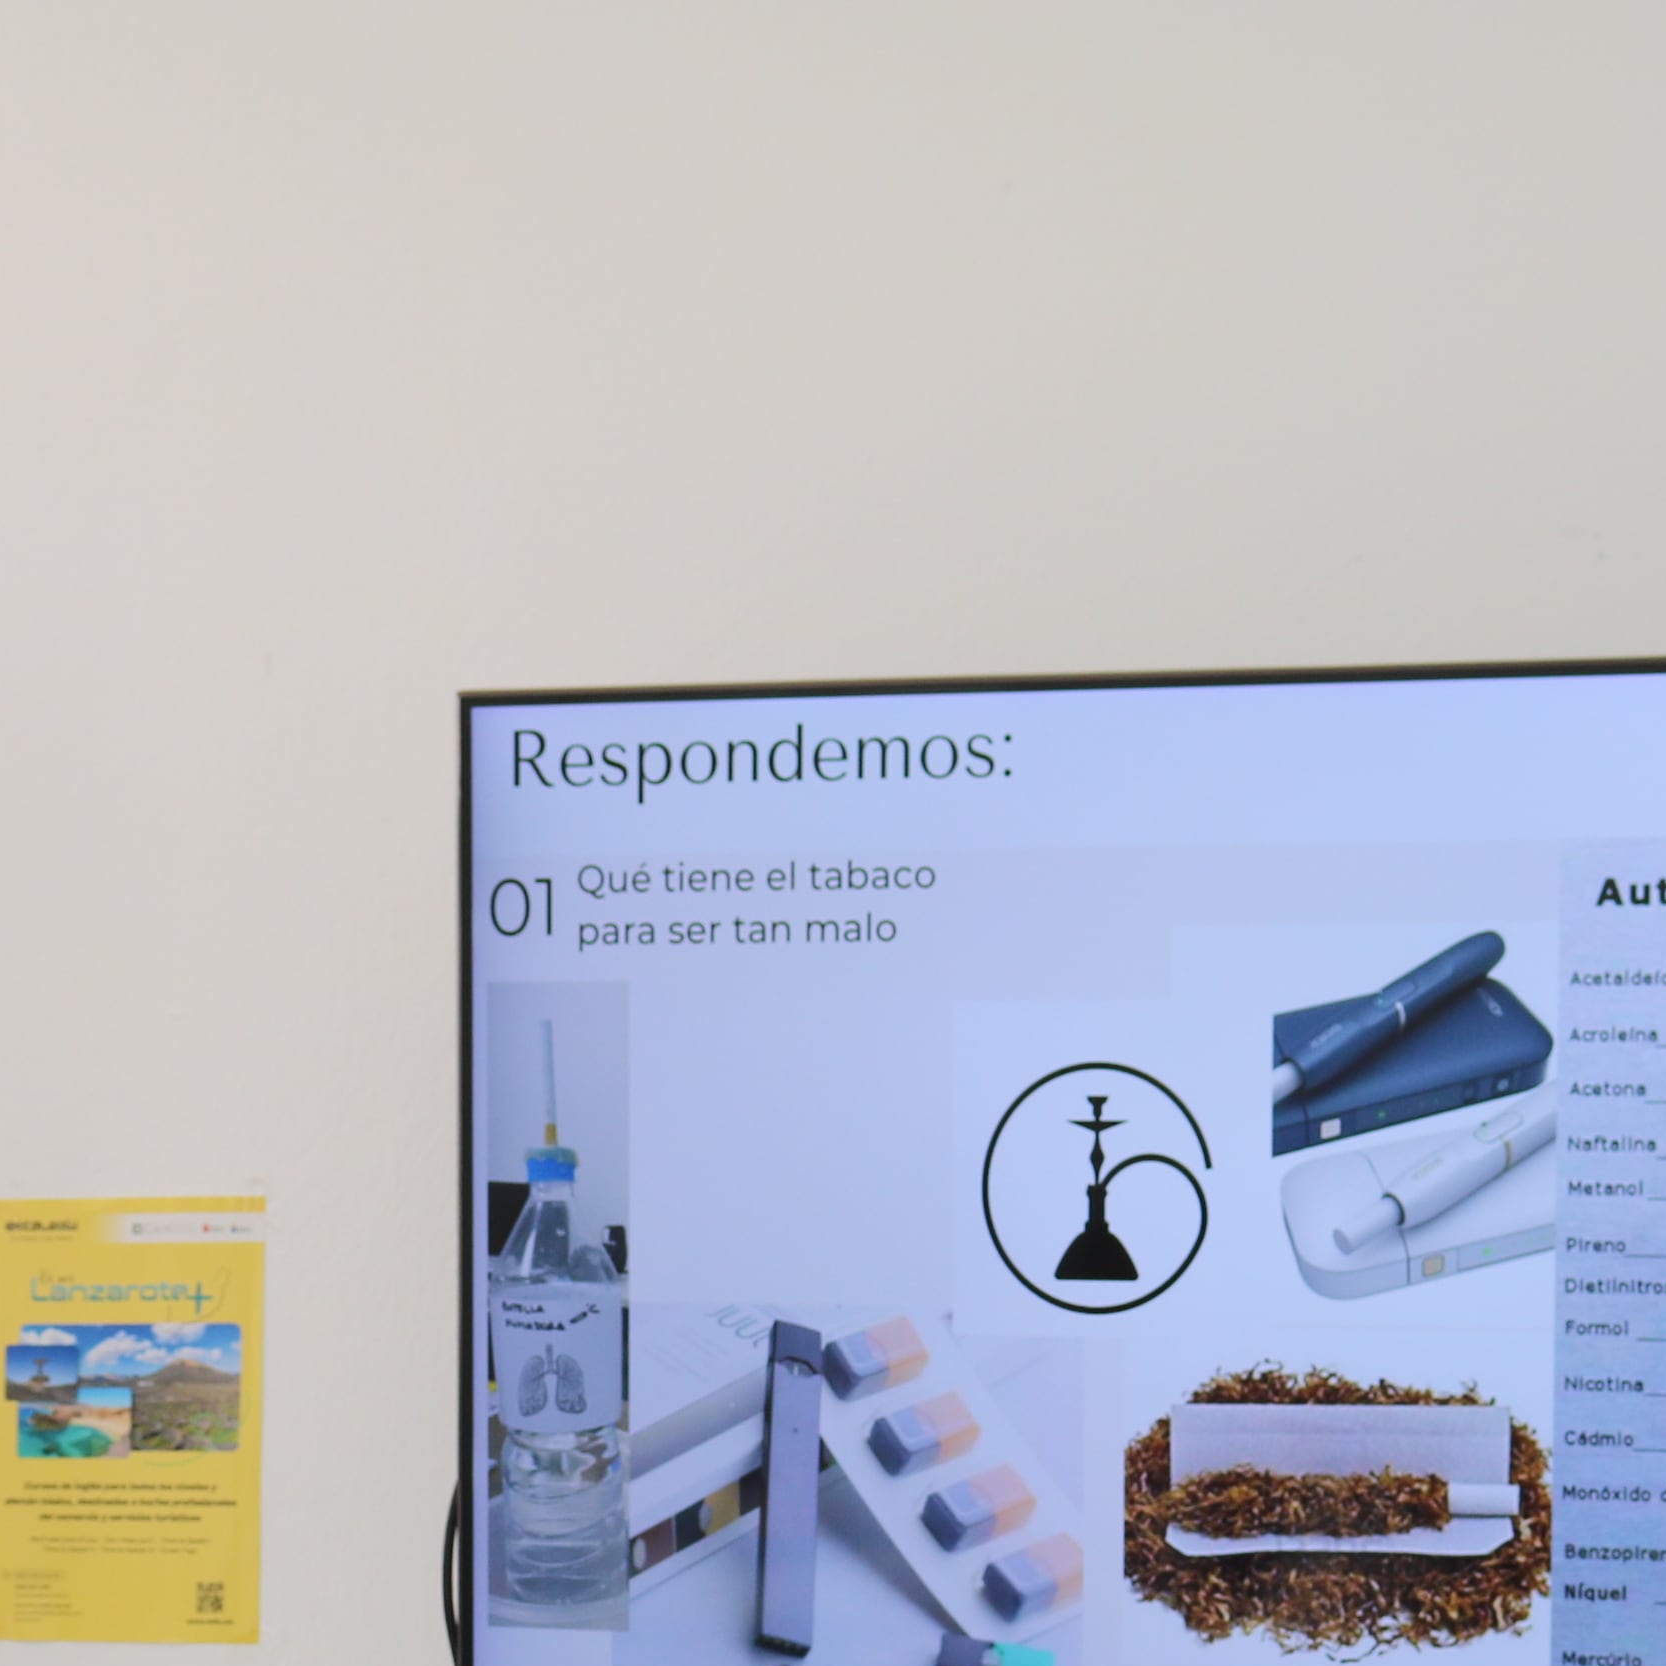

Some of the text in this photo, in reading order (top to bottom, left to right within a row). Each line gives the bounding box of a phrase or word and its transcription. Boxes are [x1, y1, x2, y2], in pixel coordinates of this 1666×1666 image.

[512, 723, 1013, 804] Respondemos:
[578, 860, 936, 898] Qué tiene el tabaco
[490, 878, 552, 936] 01
[578, 912, 897, 952] para ser tan malo
[1569, 1026, 1658, 1043] Acroleína
[1569, 1081, 1647, 1097] Acetona
[1567, 1135, 1657, 1152] Naftalina
[1567, 1180, 1644, 1197] Metanol
[1565, 1236, 1627, 1253] Pireno
[1564, 1319, 1630, 1336] Formol
[1564, 1375, 1645, 1393] Nicotina
[1564, 1429, 1635, 1447] Cádmio
[1562, 1484, 1652, 1502] Monóxido
[1564, 1583, 1628, 1602] Níquel
